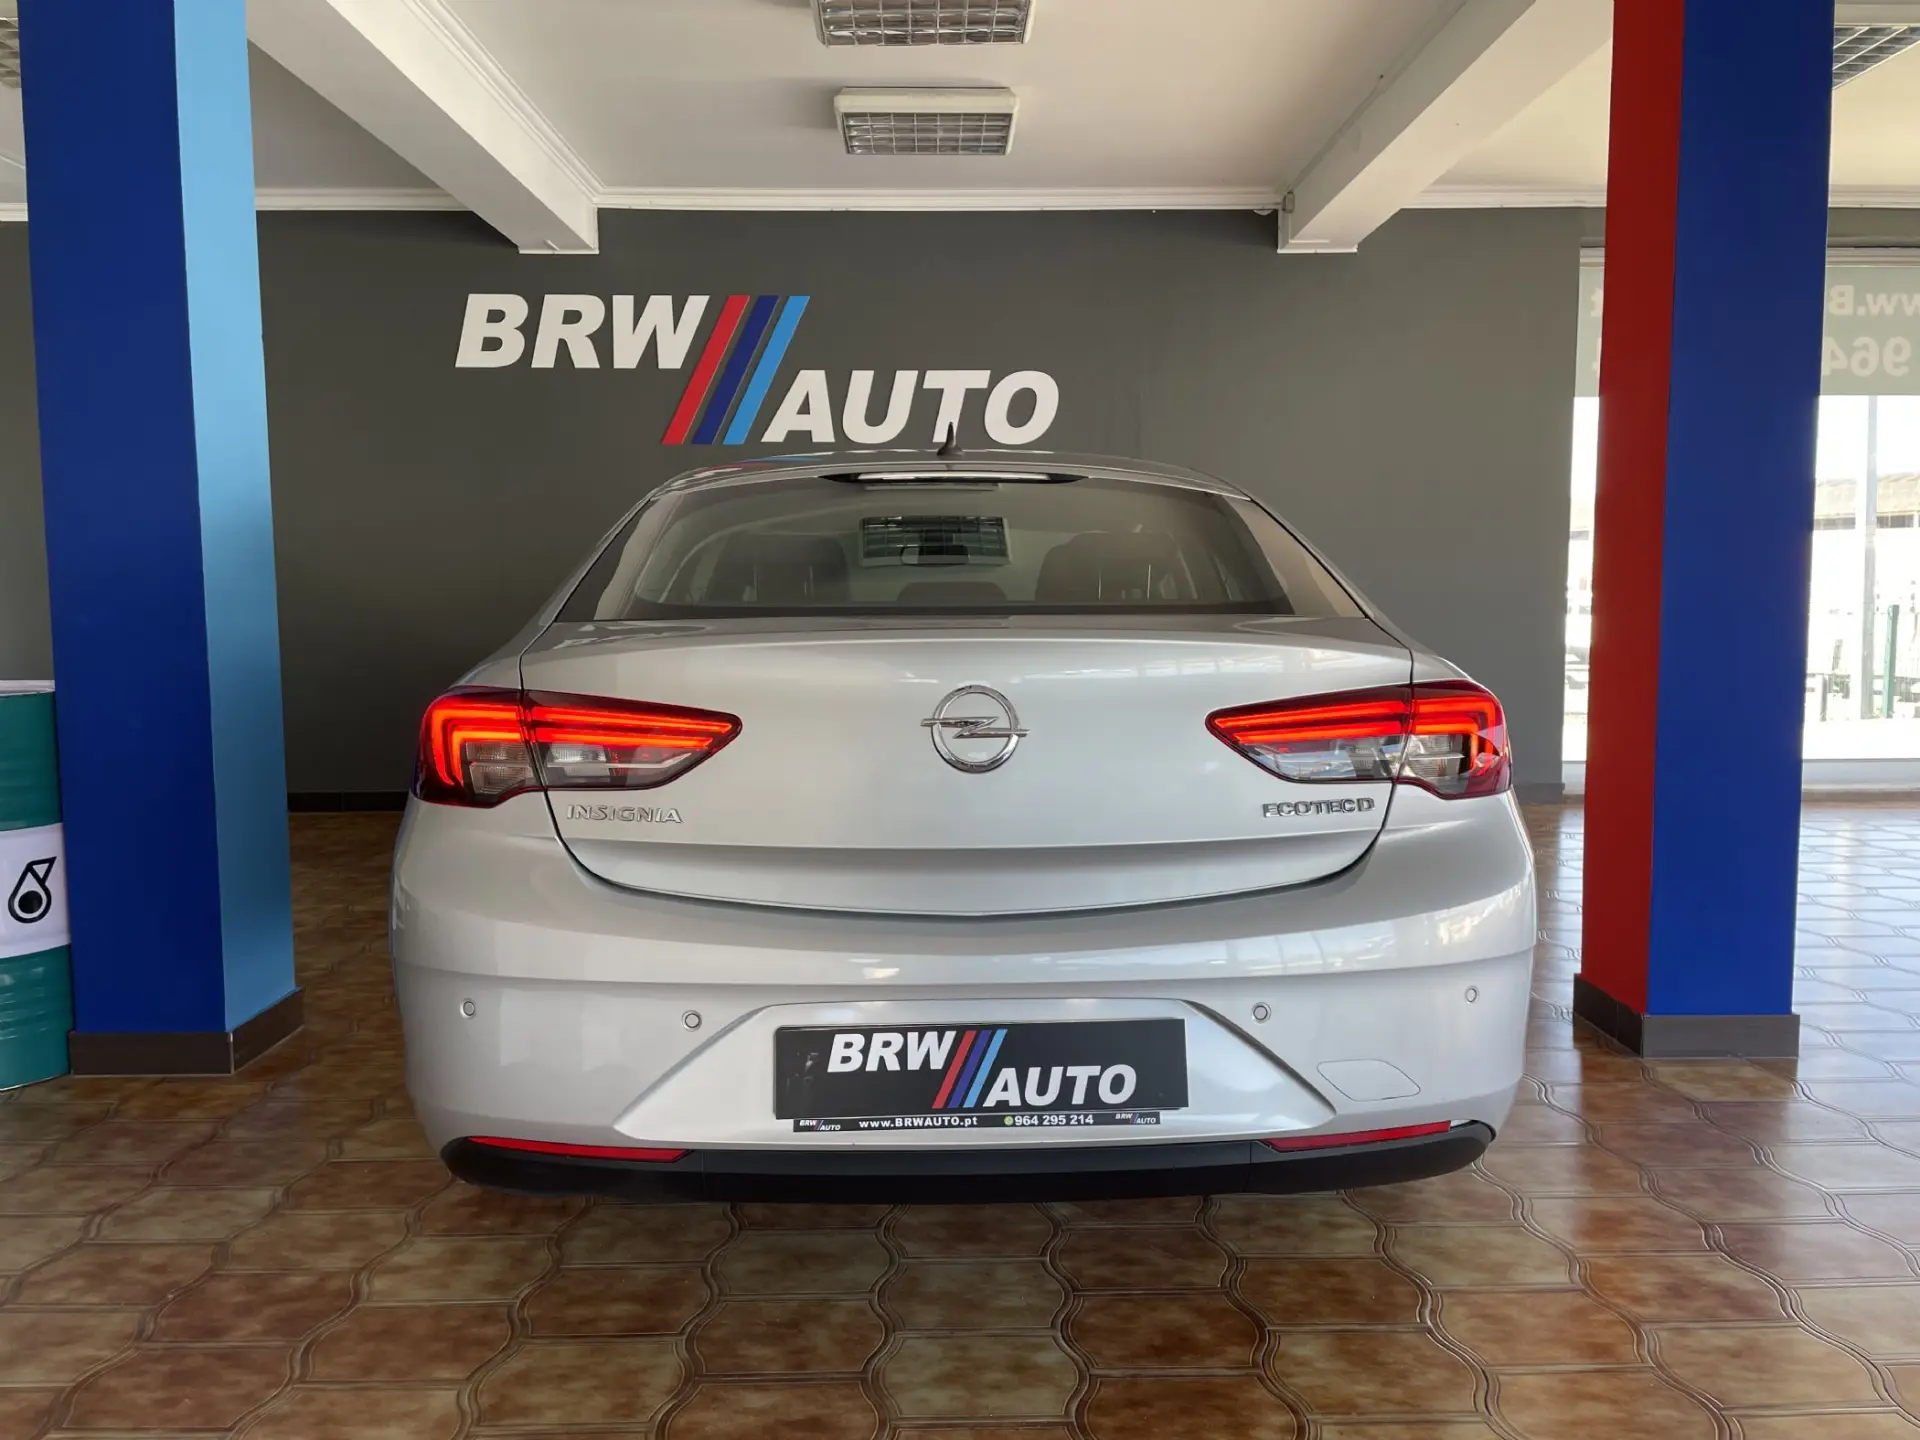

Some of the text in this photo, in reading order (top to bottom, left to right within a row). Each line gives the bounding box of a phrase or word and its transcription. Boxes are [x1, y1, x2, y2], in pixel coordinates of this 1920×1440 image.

[455, 294, 710, 369] BRW
[760, 370, 1060, 445] AUTO
[566, 804, 683, 824] INSIGNIA
[827, 1030, 956, 1073] BRW
[982, 1064, 1138, 1108] AUTO
[858, 1116, 978, 1128] www.BRWAUTO.pt
[1014, 1113, 1094, 1126] 964 295 214
[1115, 1112, 1133, 1120] BRW
[1136, 1117, 1157, 1125] AUTO
[799, 1119, 818, 1127] BRW
[819, 1124, 842, 1132] AUTO
